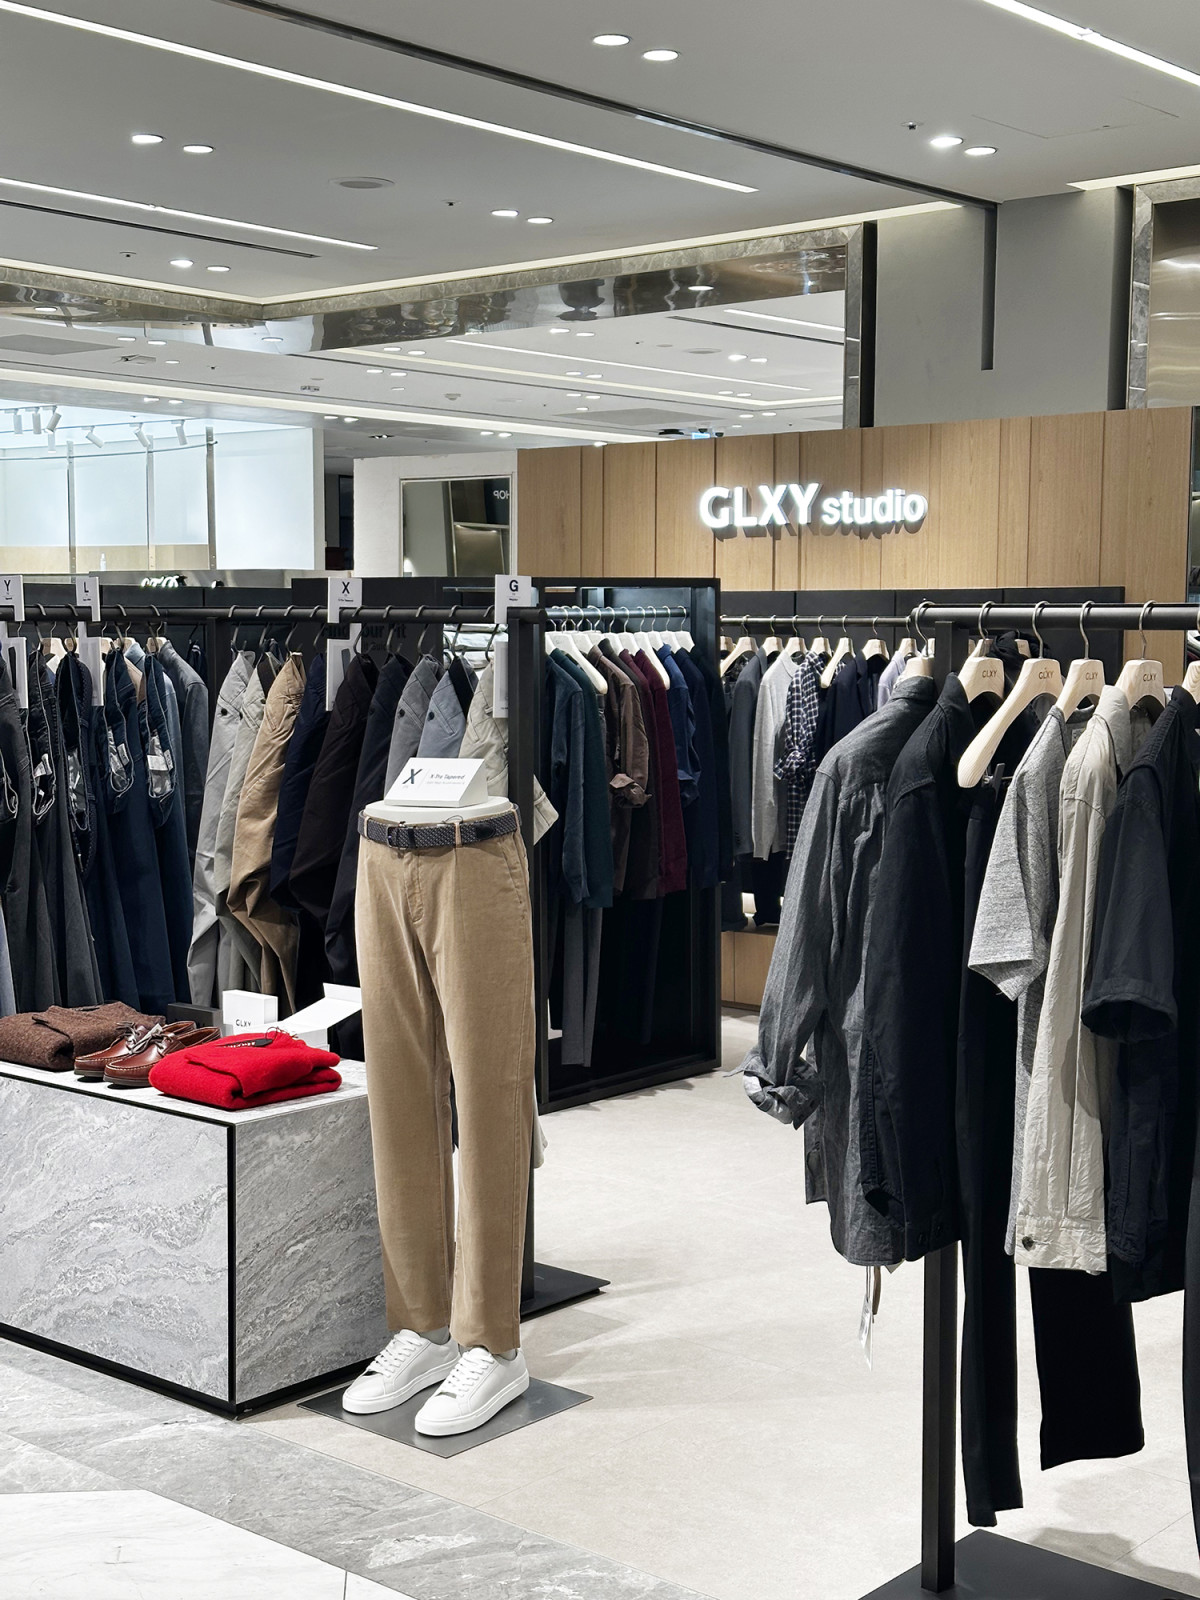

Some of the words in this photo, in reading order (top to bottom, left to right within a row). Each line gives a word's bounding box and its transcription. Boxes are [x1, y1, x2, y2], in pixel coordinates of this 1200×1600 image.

[699, 483, 822, 528] GLXY
[822, 488, 928, 525] studio
[4, 579, 11, 592] Y
[83, 581, 89, 593] L
[342, 581, 350, 594] X
[509, 579, 519, 592] G
[402, 768, 423, 785] X
